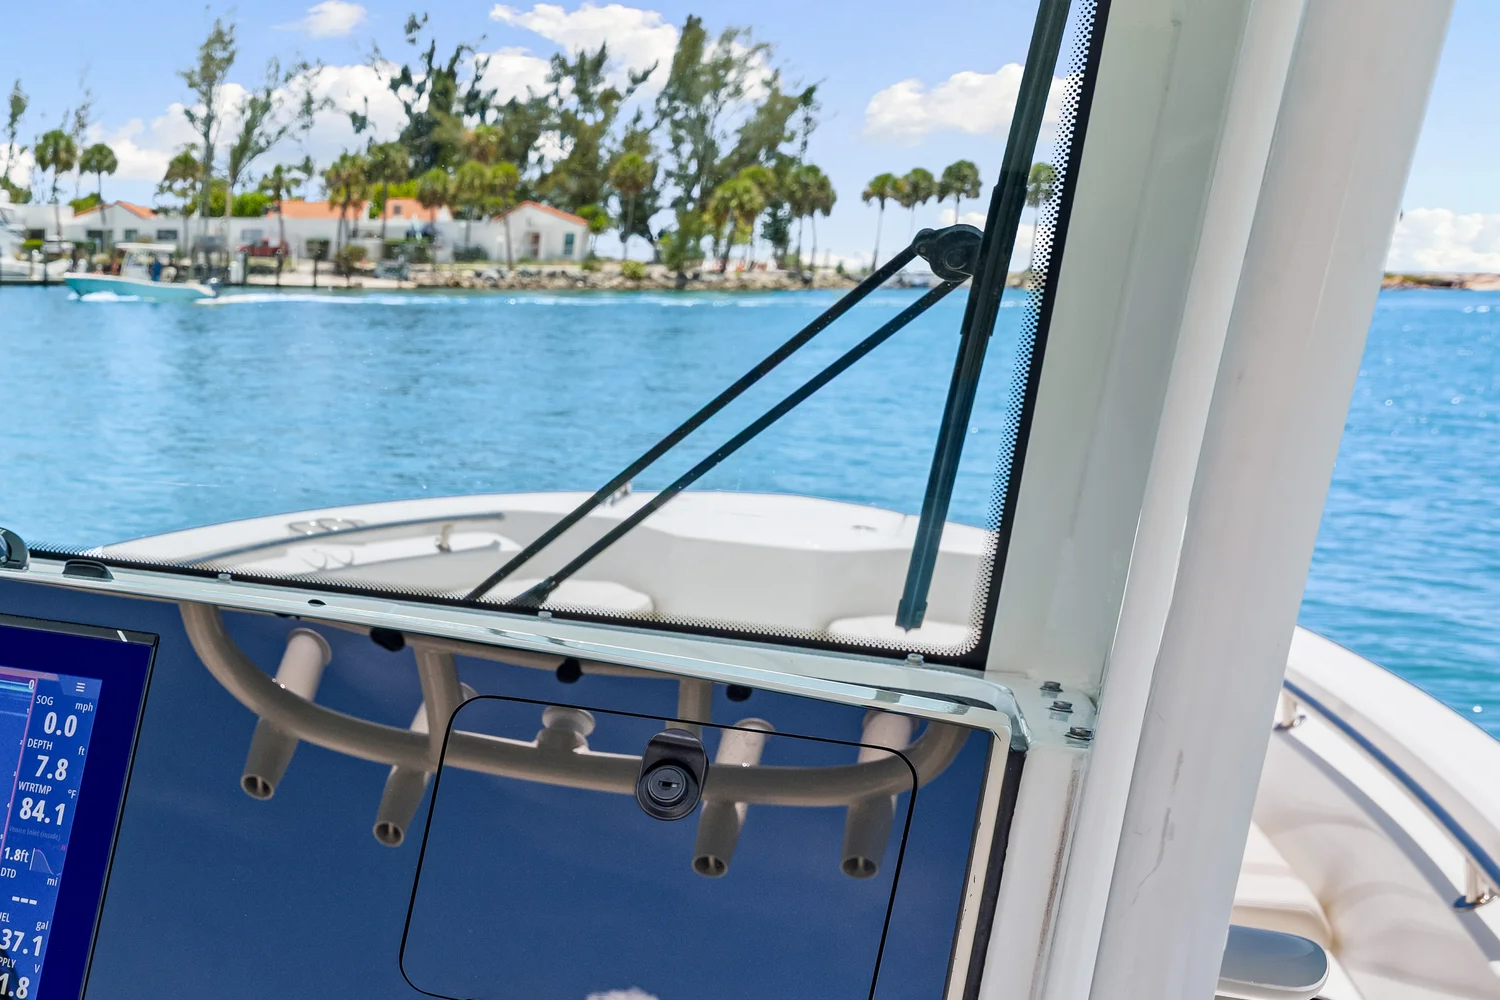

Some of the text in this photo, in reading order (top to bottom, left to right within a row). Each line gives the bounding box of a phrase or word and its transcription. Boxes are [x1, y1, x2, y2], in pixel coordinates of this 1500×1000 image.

[36, 694, 54, 706] SOG
[75, 702, 93, 713] mph
[43, 711, 78, 738] 0.0
[27, 738, 53, 751] DEPTH
[78, 746, 85, 756] ft
[35, 755, 69, 781] 7.8
[18, 781, 52, 795] WTRTMP
[68, 789, 77, 799] °F
[19, 797, 66, 826] 84.1
[0, 867, 17, 879] DTD
[46, 877, 58, 886] mi
[36, 921, 49, 931] gal
[34, 964, 40, 973] V
